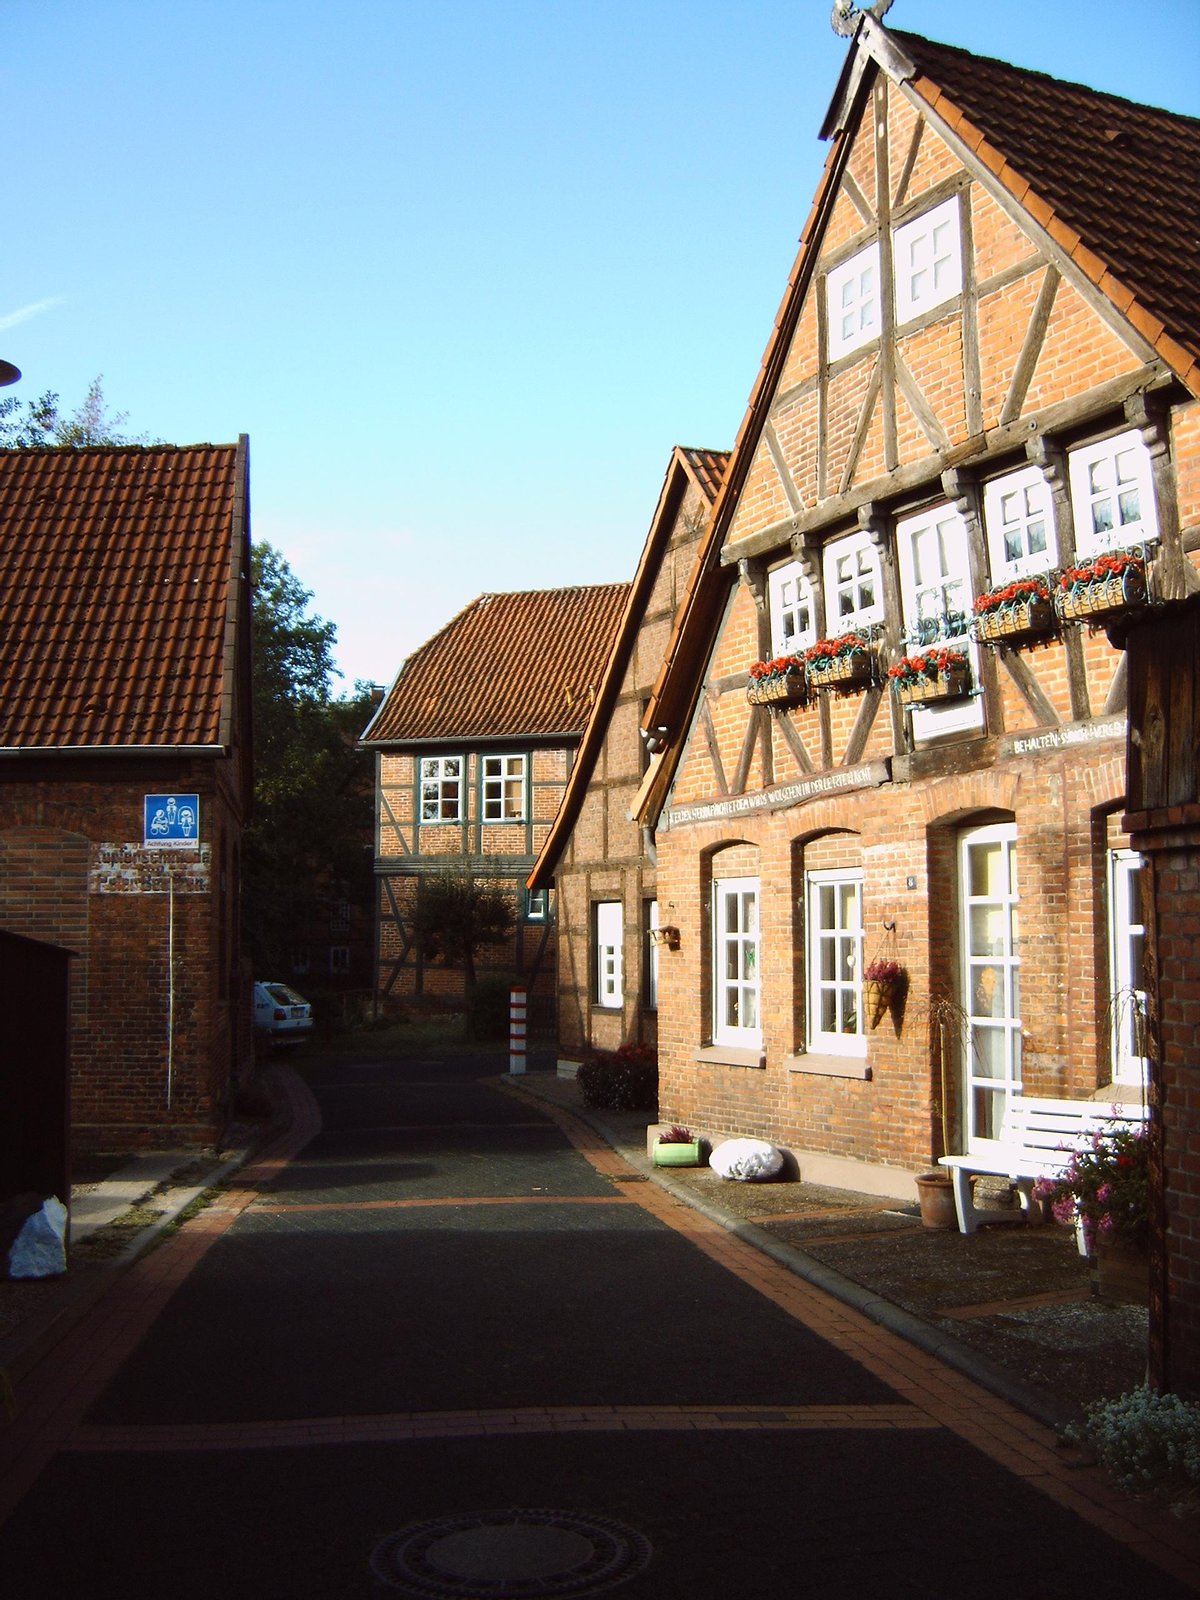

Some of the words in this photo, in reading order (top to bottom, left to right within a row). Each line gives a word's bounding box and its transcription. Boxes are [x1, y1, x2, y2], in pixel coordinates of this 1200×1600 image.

[1014, 732, 1058, 754] BEHALTEN
[802, 781, 810, 796] IN
[810, 778, 823, 793] DER
[147, 840, 172, 848] Achtung
[908, 877, 913, 887] 8
